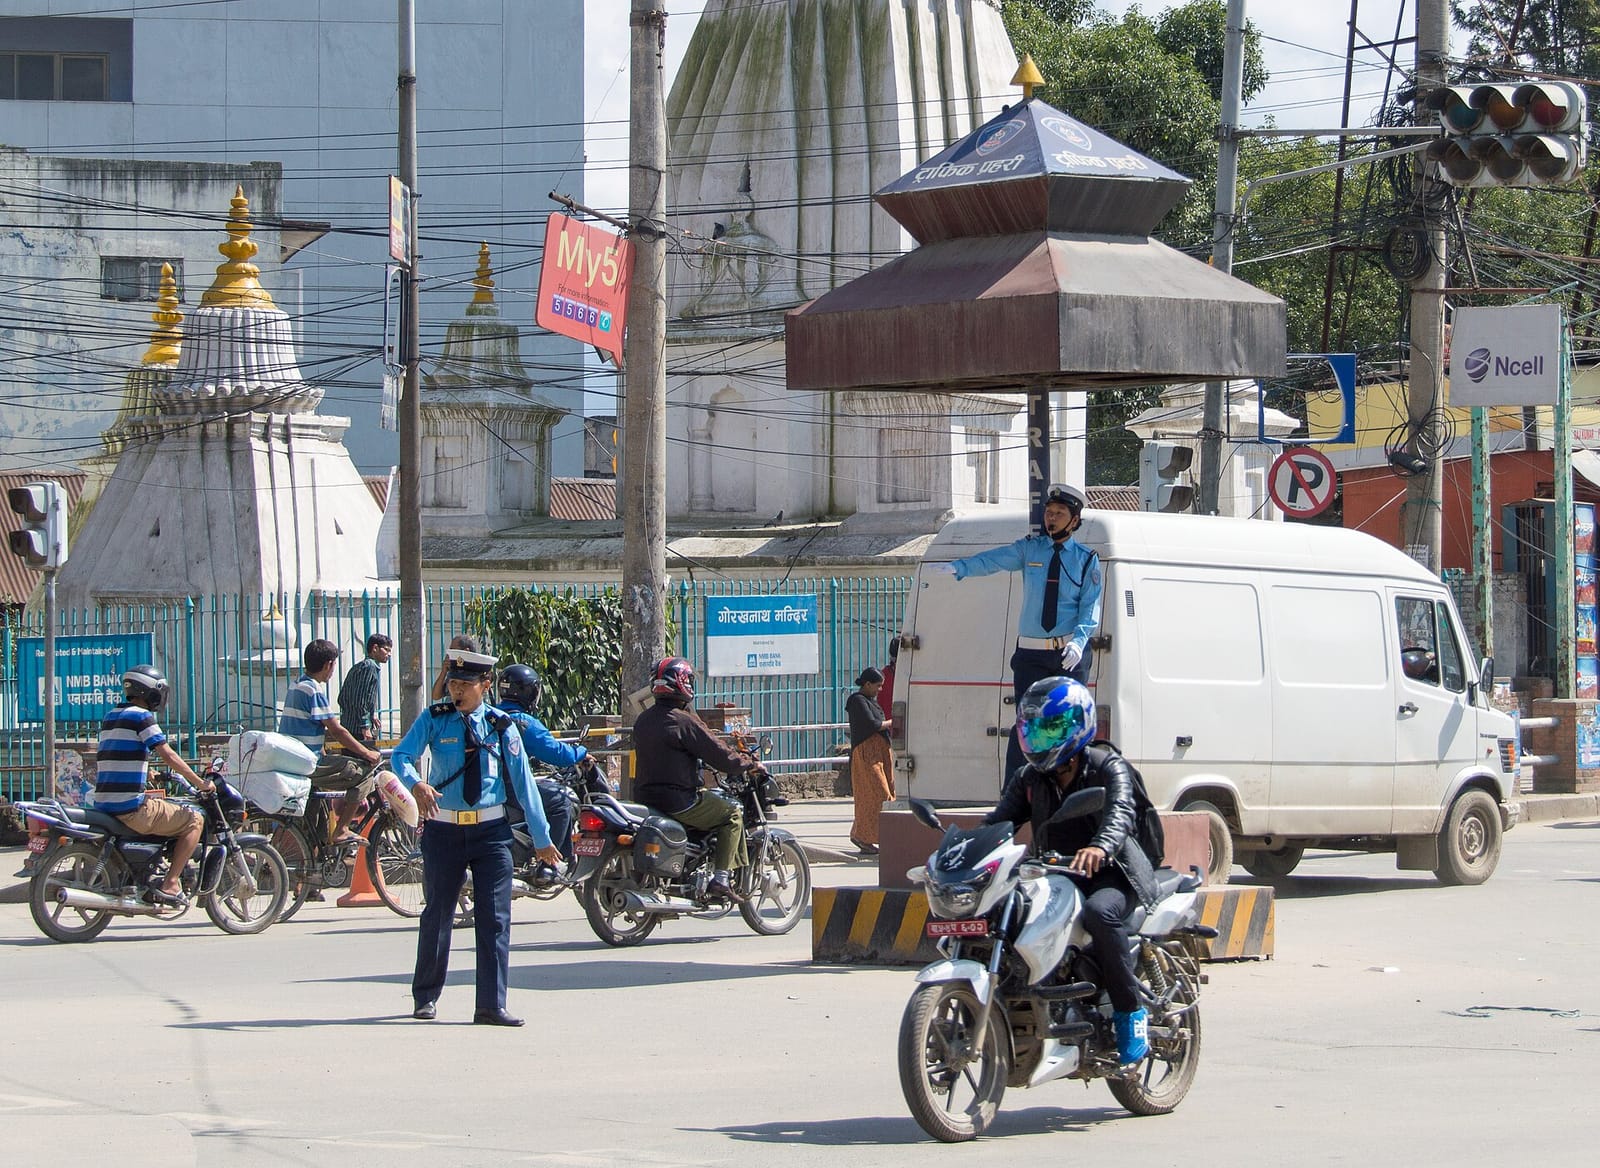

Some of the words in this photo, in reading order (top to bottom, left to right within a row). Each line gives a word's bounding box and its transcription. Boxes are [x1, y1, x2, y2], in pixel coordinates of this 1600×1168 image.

[557, 231, 618, 288] My5
[1495, 356, 1543, 376] Ncell
[1288, 460, 1323, 503] P
[718, 606, 771, 623] गोरखनाथ
[774, 605, 808, 624] मन्दिर
[66, 676, 90, 688] NMB
[93, 674, 121, 687] BANK
